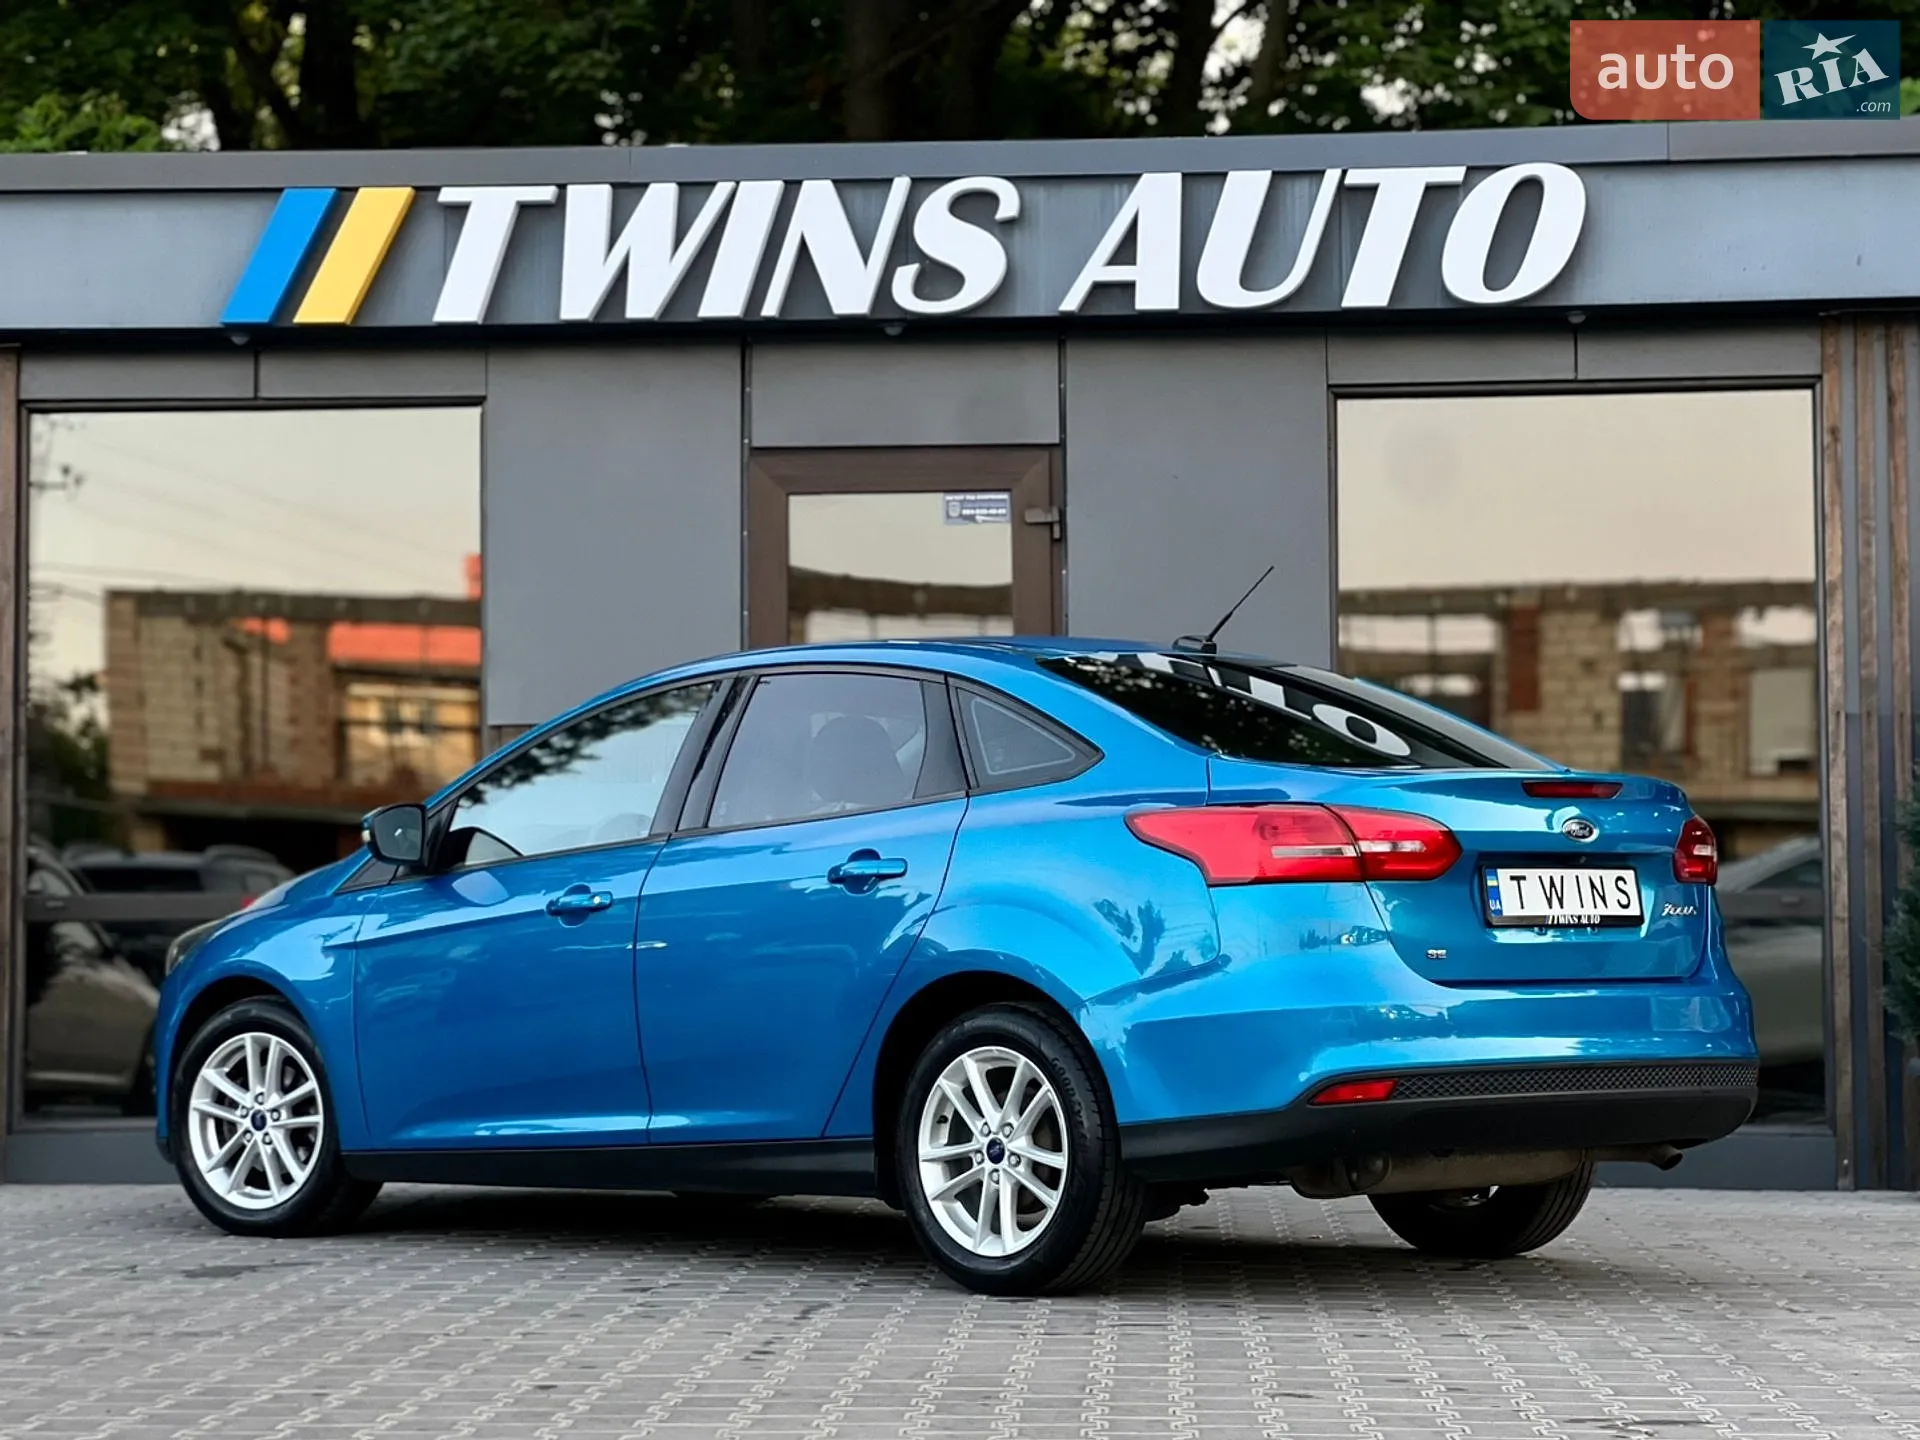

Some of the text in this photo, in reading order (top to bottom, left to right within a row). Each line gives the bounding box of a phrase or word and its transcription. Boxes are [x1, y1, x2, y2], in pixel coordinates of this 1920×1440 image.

[432, 161, 1587, 324] TWINS AUTO
[1489, 899, 1502, 911] UA
[1509, 875, 1631, 910] TWINS
